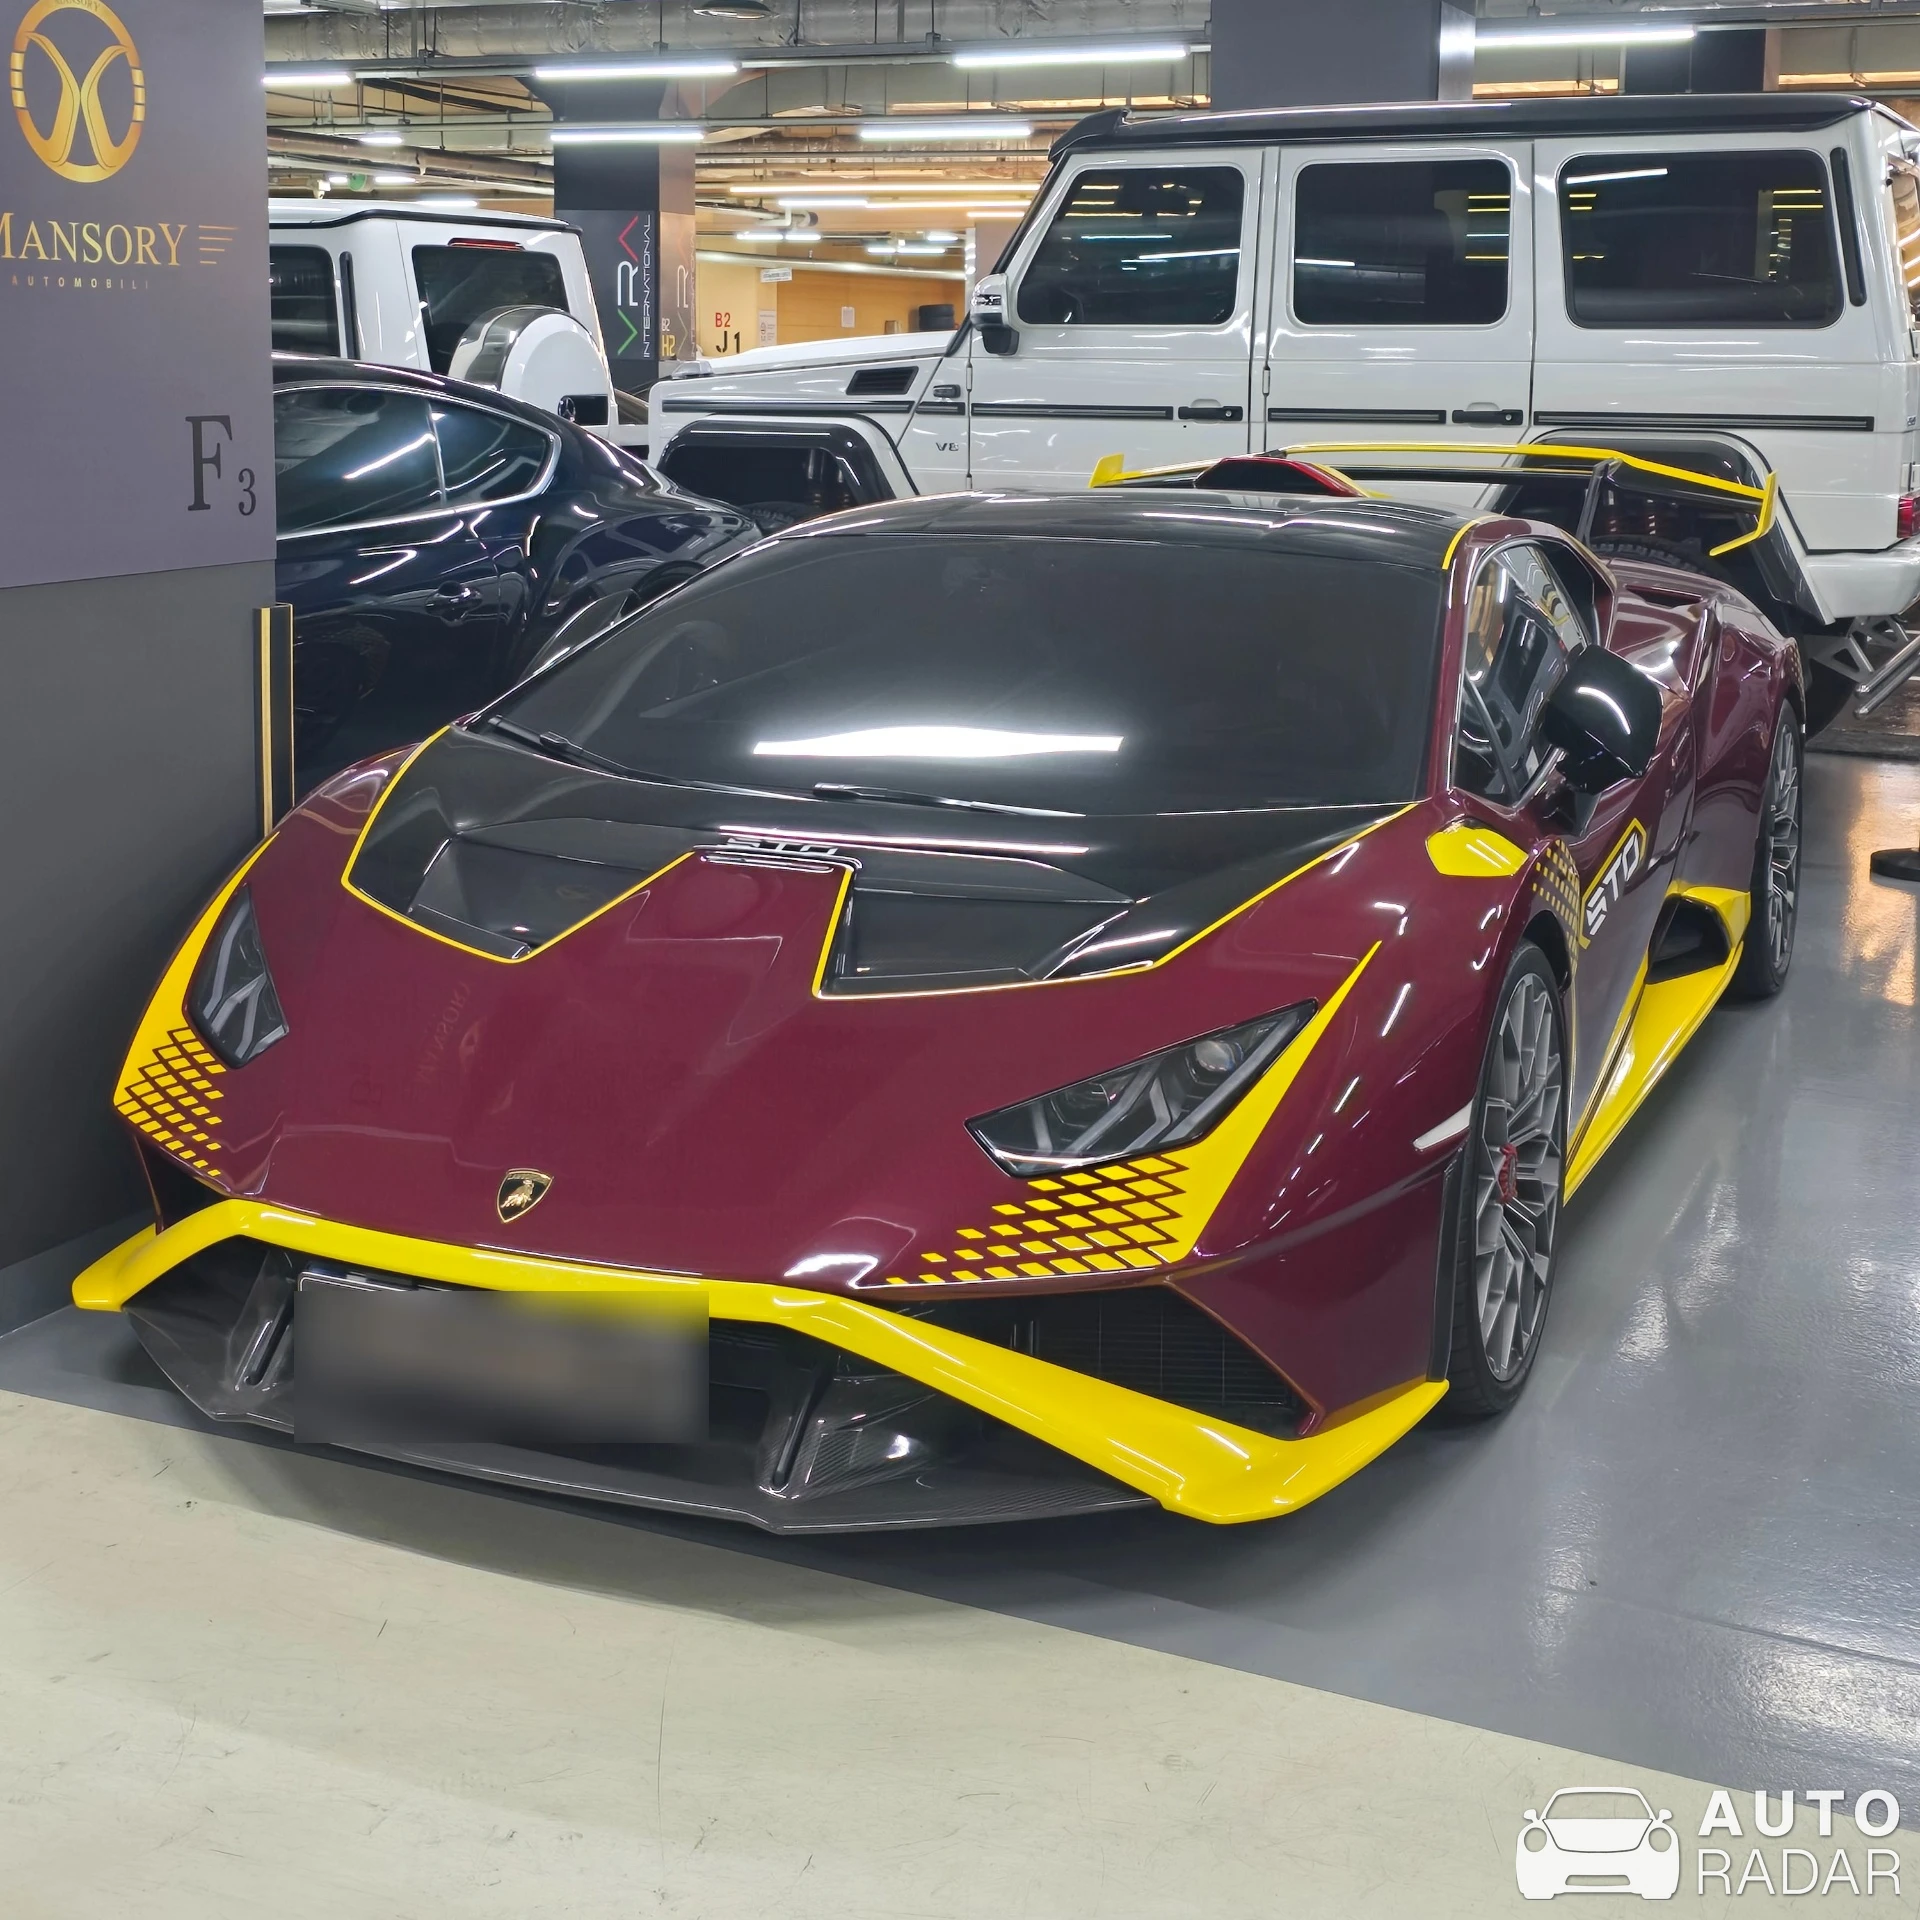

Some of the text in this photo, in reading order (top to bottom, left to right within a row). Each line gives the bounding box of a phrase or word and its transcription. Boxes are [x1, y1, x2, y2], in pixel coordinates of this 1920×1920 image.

[12, 274, 149, 290] AUTOMOBILI
[643, 214, 651, 358] INTERNATIONAL
[661, 317, 671, 332] B2
[715, 312, 731, 328] B2
[661, 334, 676, 357] H2
[935, 442, 959, 452] V8
[1586, 832, 1640, 936] STO
